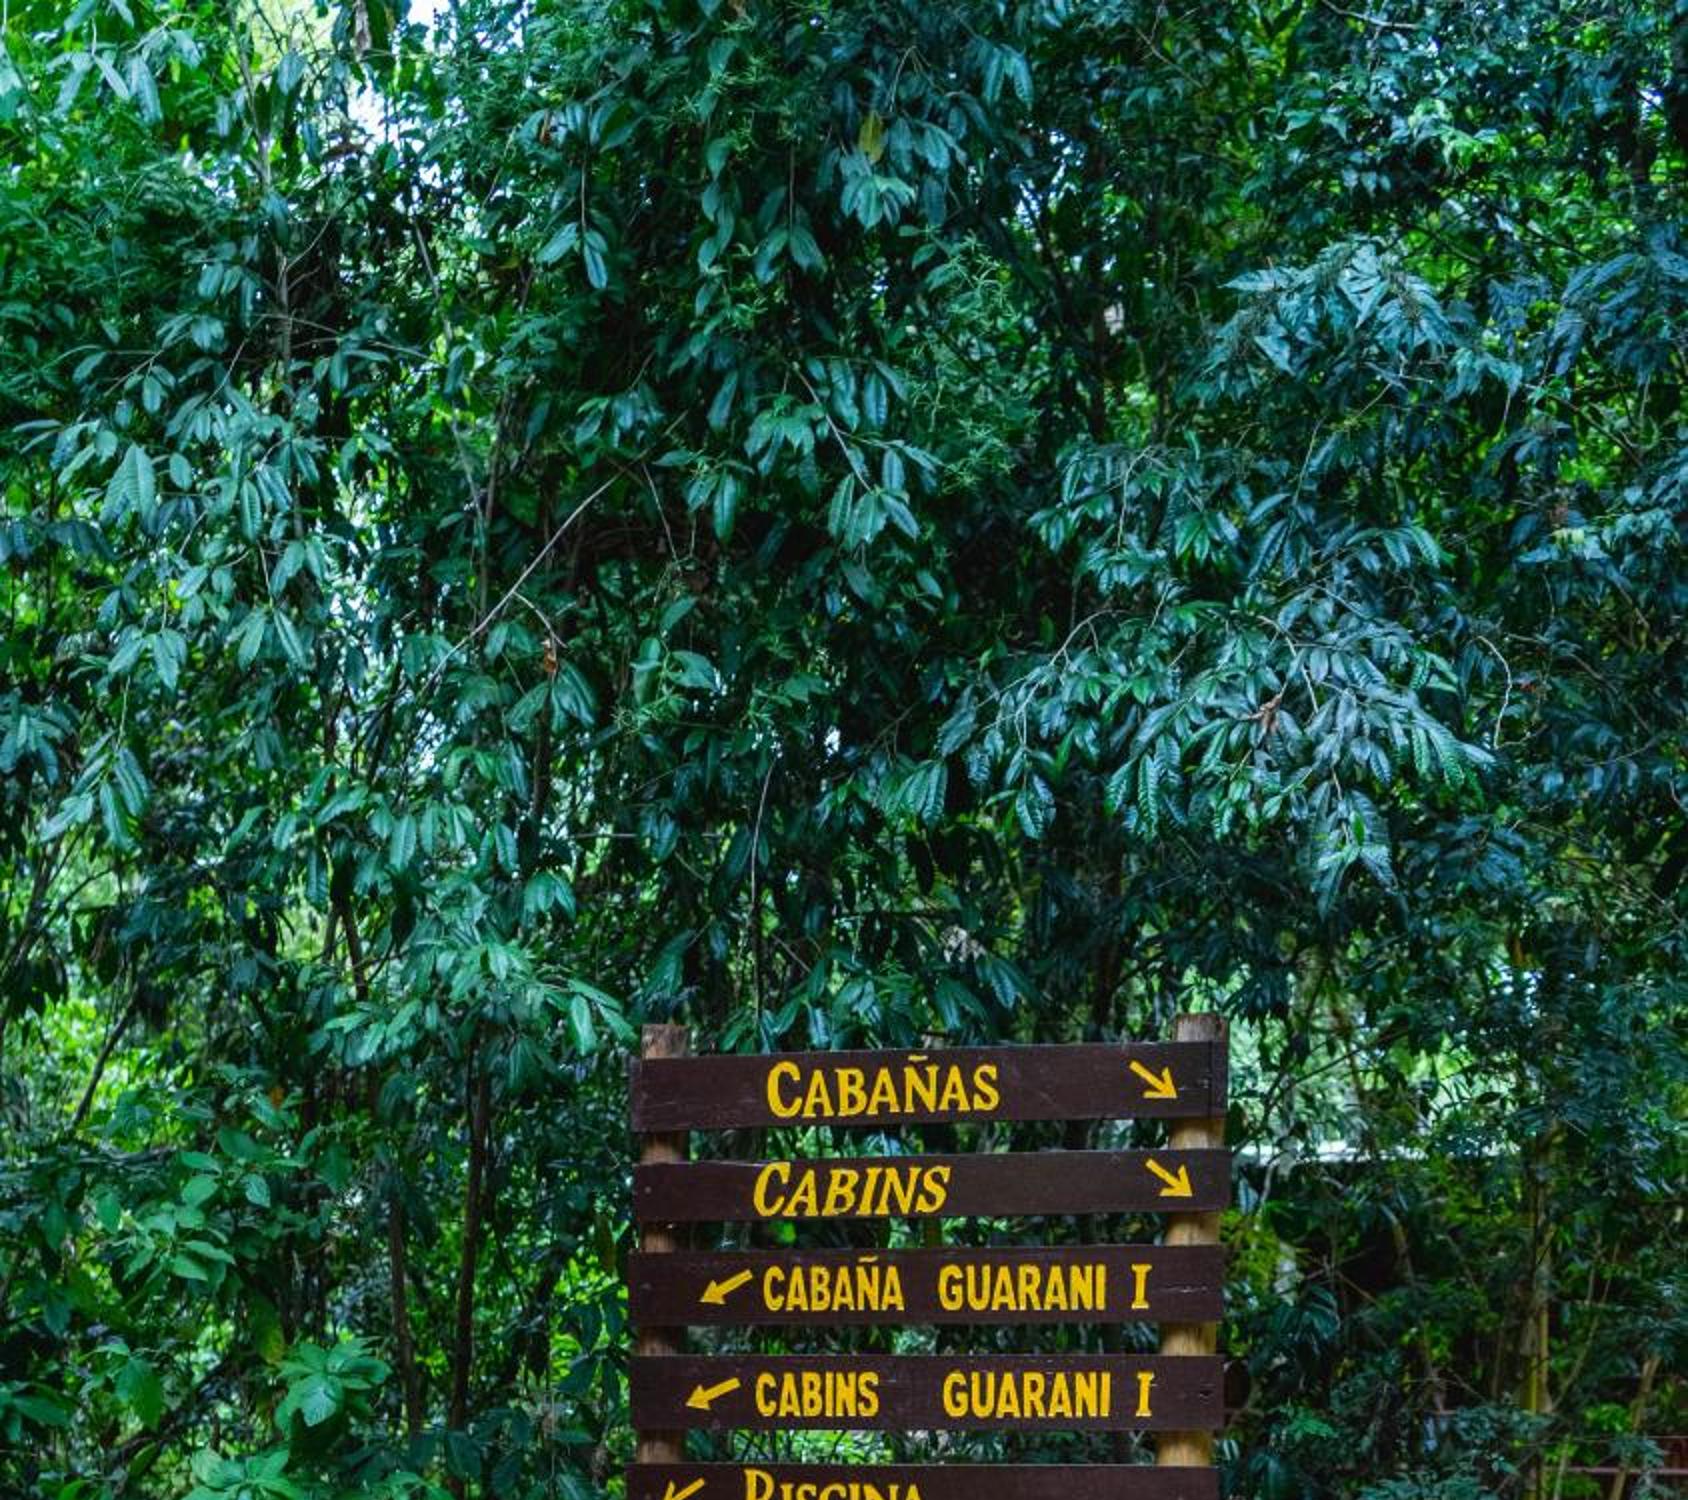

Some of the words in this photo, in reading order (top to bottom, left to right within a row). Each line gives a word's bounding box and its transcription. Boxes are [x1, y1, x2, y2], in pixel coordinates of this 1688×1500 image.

[767, 1055, 999, 1118] CABAÑAS
[754, 1162, 950, 1216] CABINS
[763, 1256, 904, 1311] CABAÑA
[938, 1264, 1106, 1311] GUARANI
[1131, 1264, 1152, 1309] I
[755, 1372, 879, 1417] CABINS
[943, 1371, 1110, 1418] GUARANI
[1136, 1372, 1153, 1417] I
